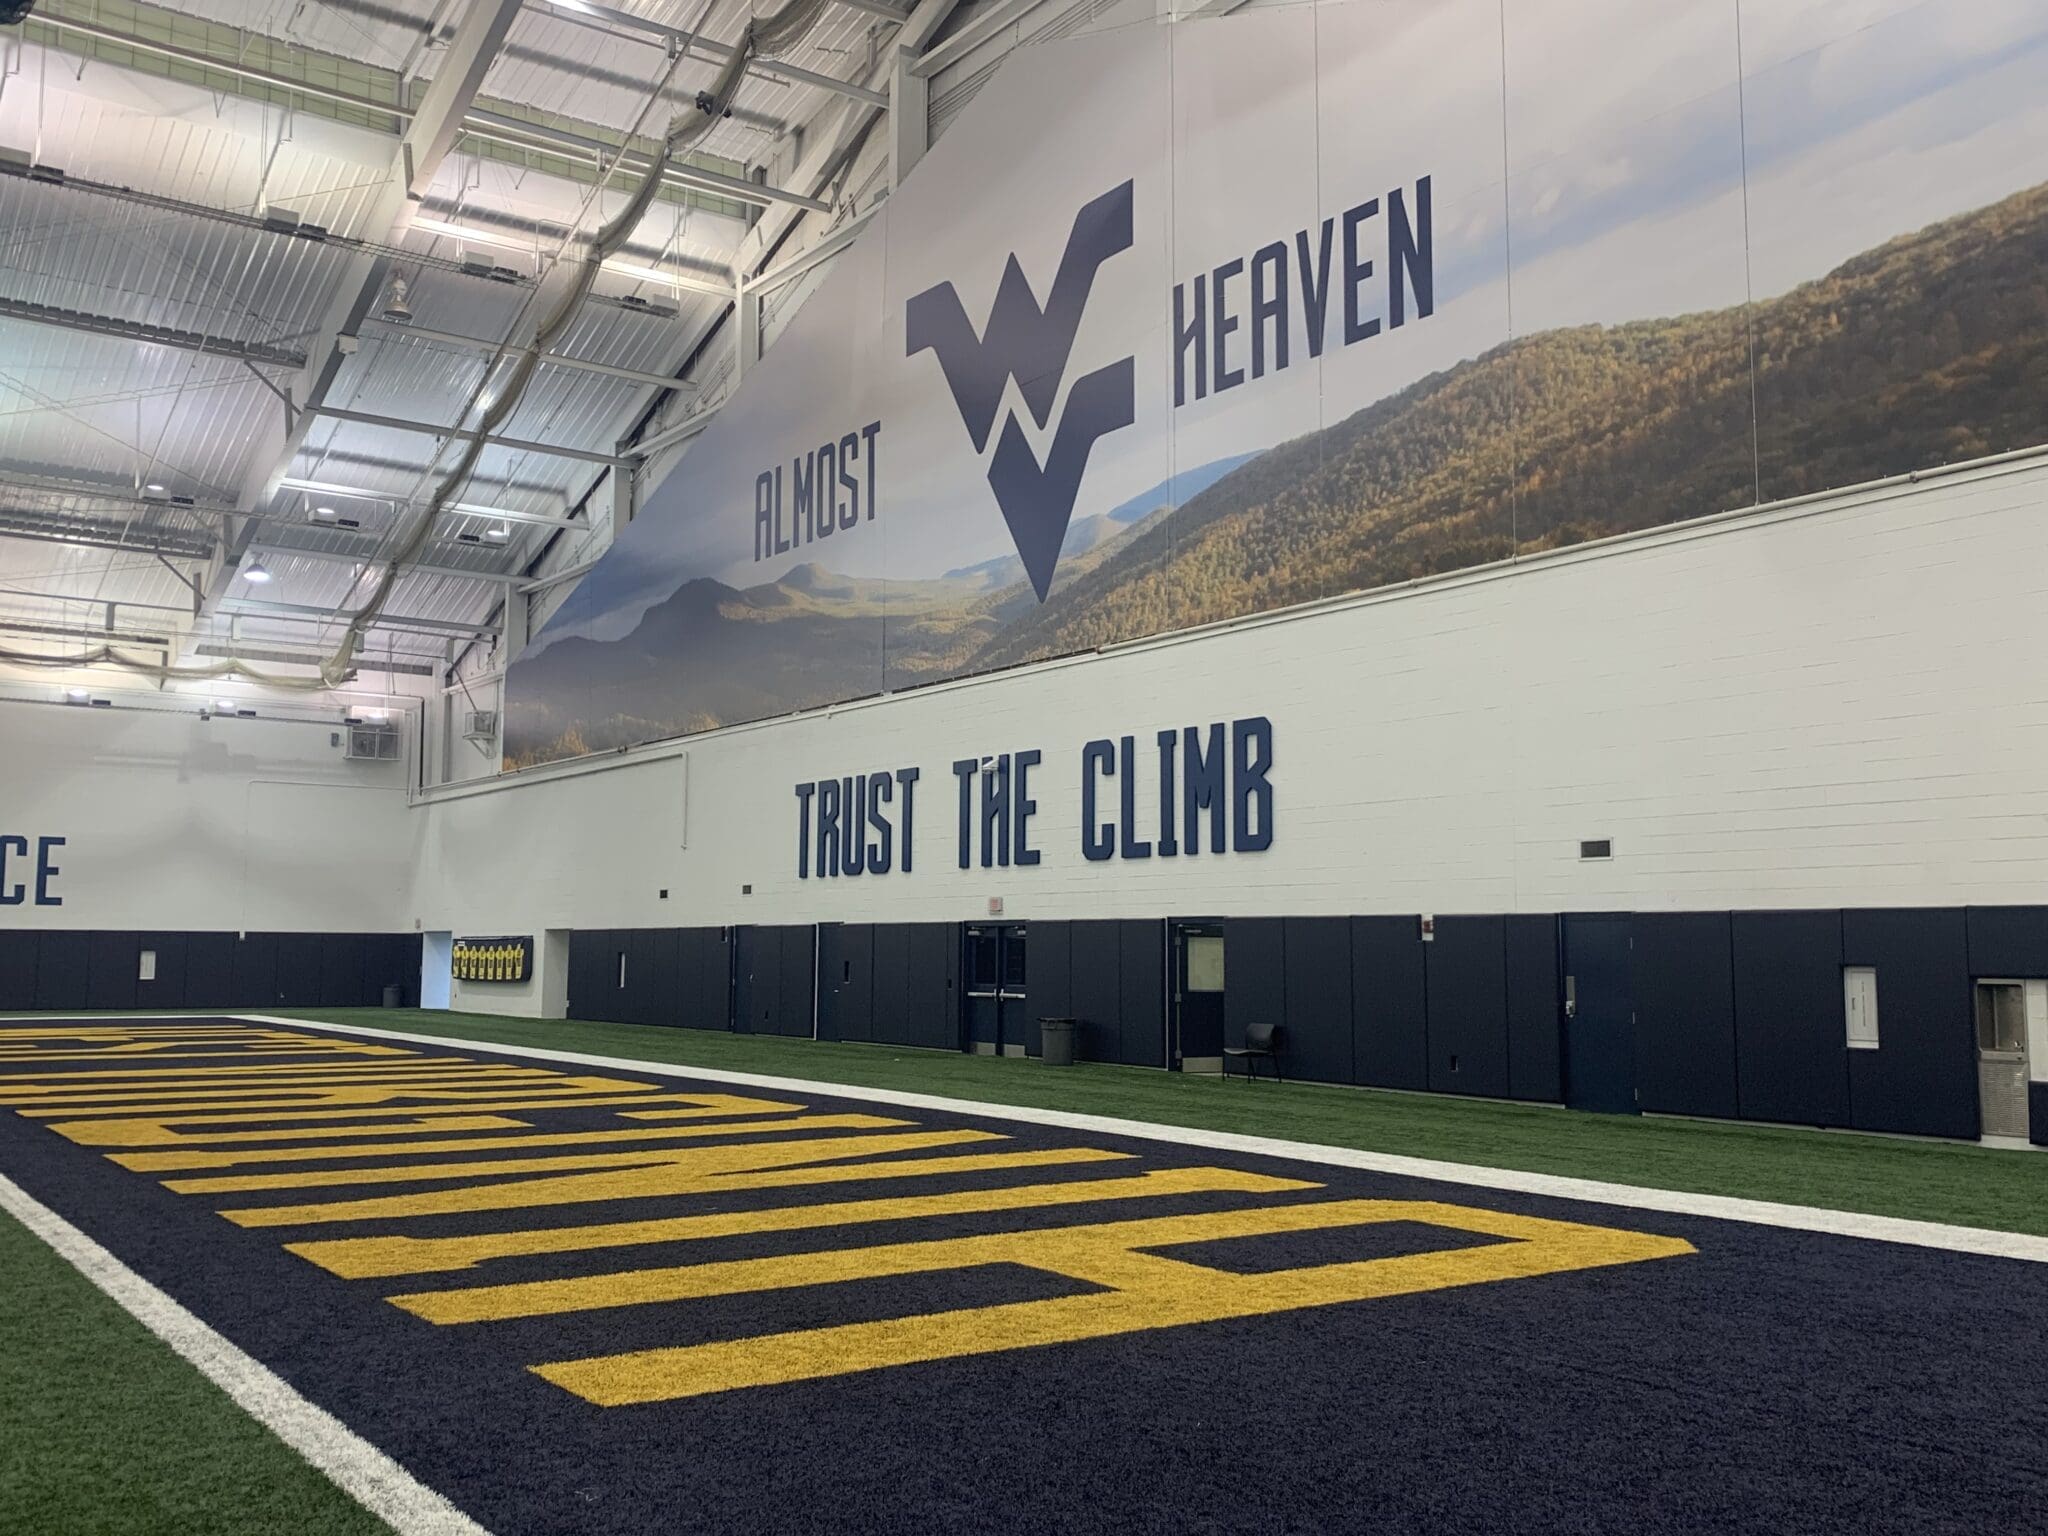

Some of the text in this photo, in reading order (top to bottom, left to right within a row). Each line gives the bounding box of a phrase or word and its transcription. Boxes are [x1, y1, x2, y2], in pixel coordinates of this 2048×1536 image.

[754, 174, 1434, 562] ALMOST HEAVEN
[795, 716, 1274, 879] TRUST THE CLIMB
[0, 1057, 1701, 1409] VIRGINIA
